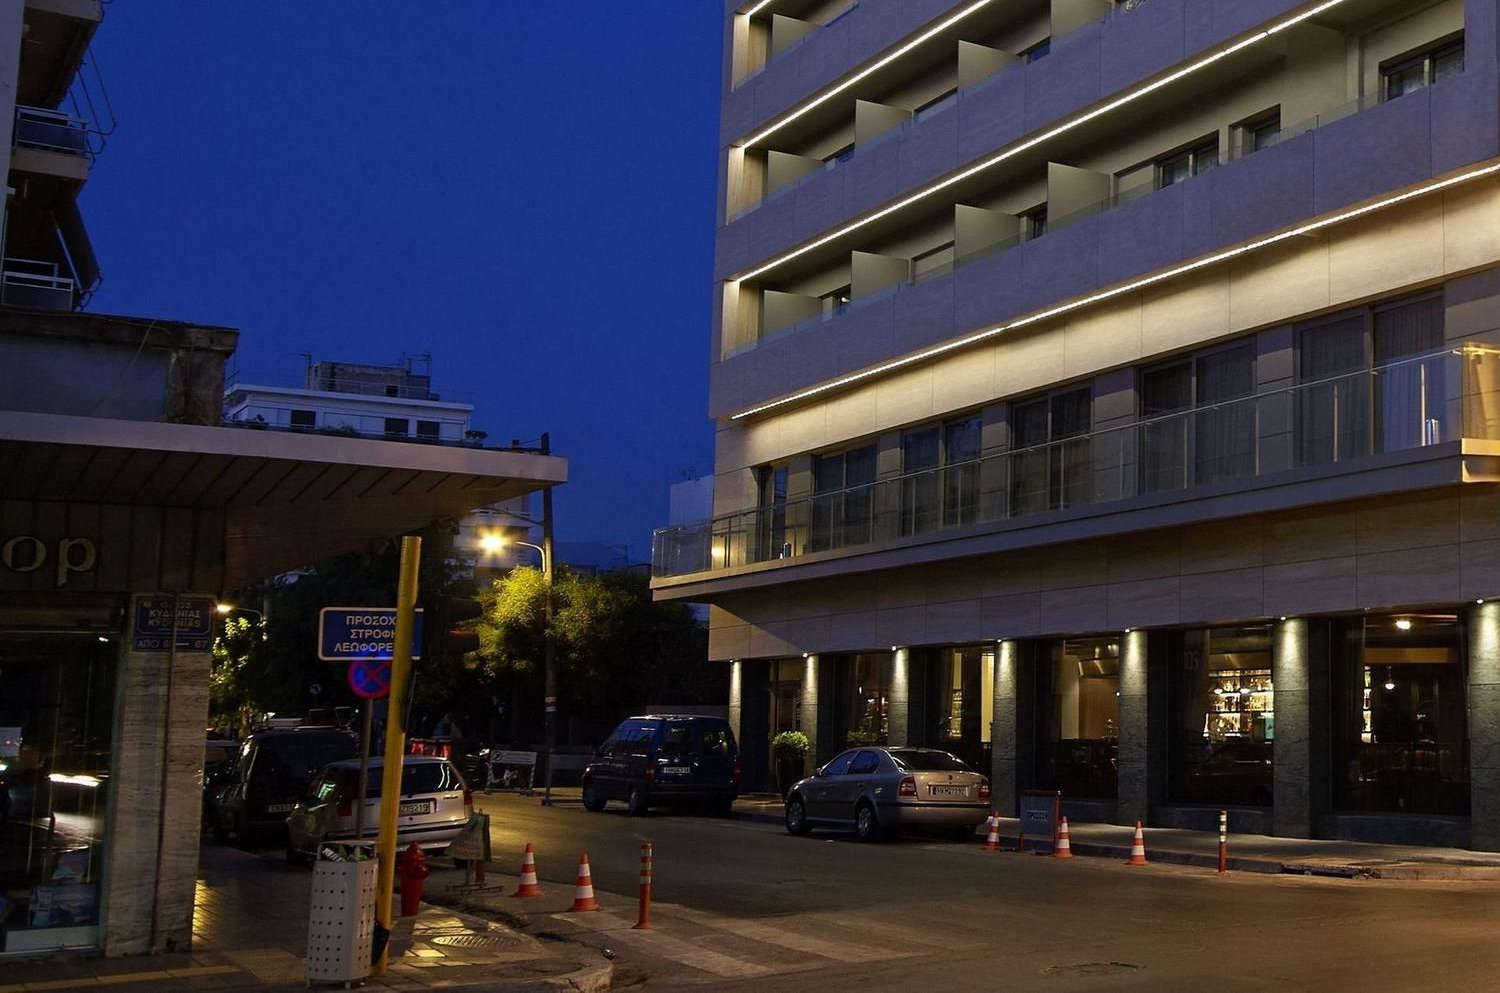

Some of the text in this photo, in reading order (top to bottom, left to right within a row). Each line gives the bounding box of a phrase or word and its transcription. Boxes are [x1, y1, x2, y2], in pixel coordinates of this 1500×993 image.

[149, 608, 201, 618] ΚΥΔΝΙΑΣ
[346, 615, 397, 626] ΠΡΟΣΟΧ
[334, 642, 394, 653] ΛΕΩΦΟΡΕ
